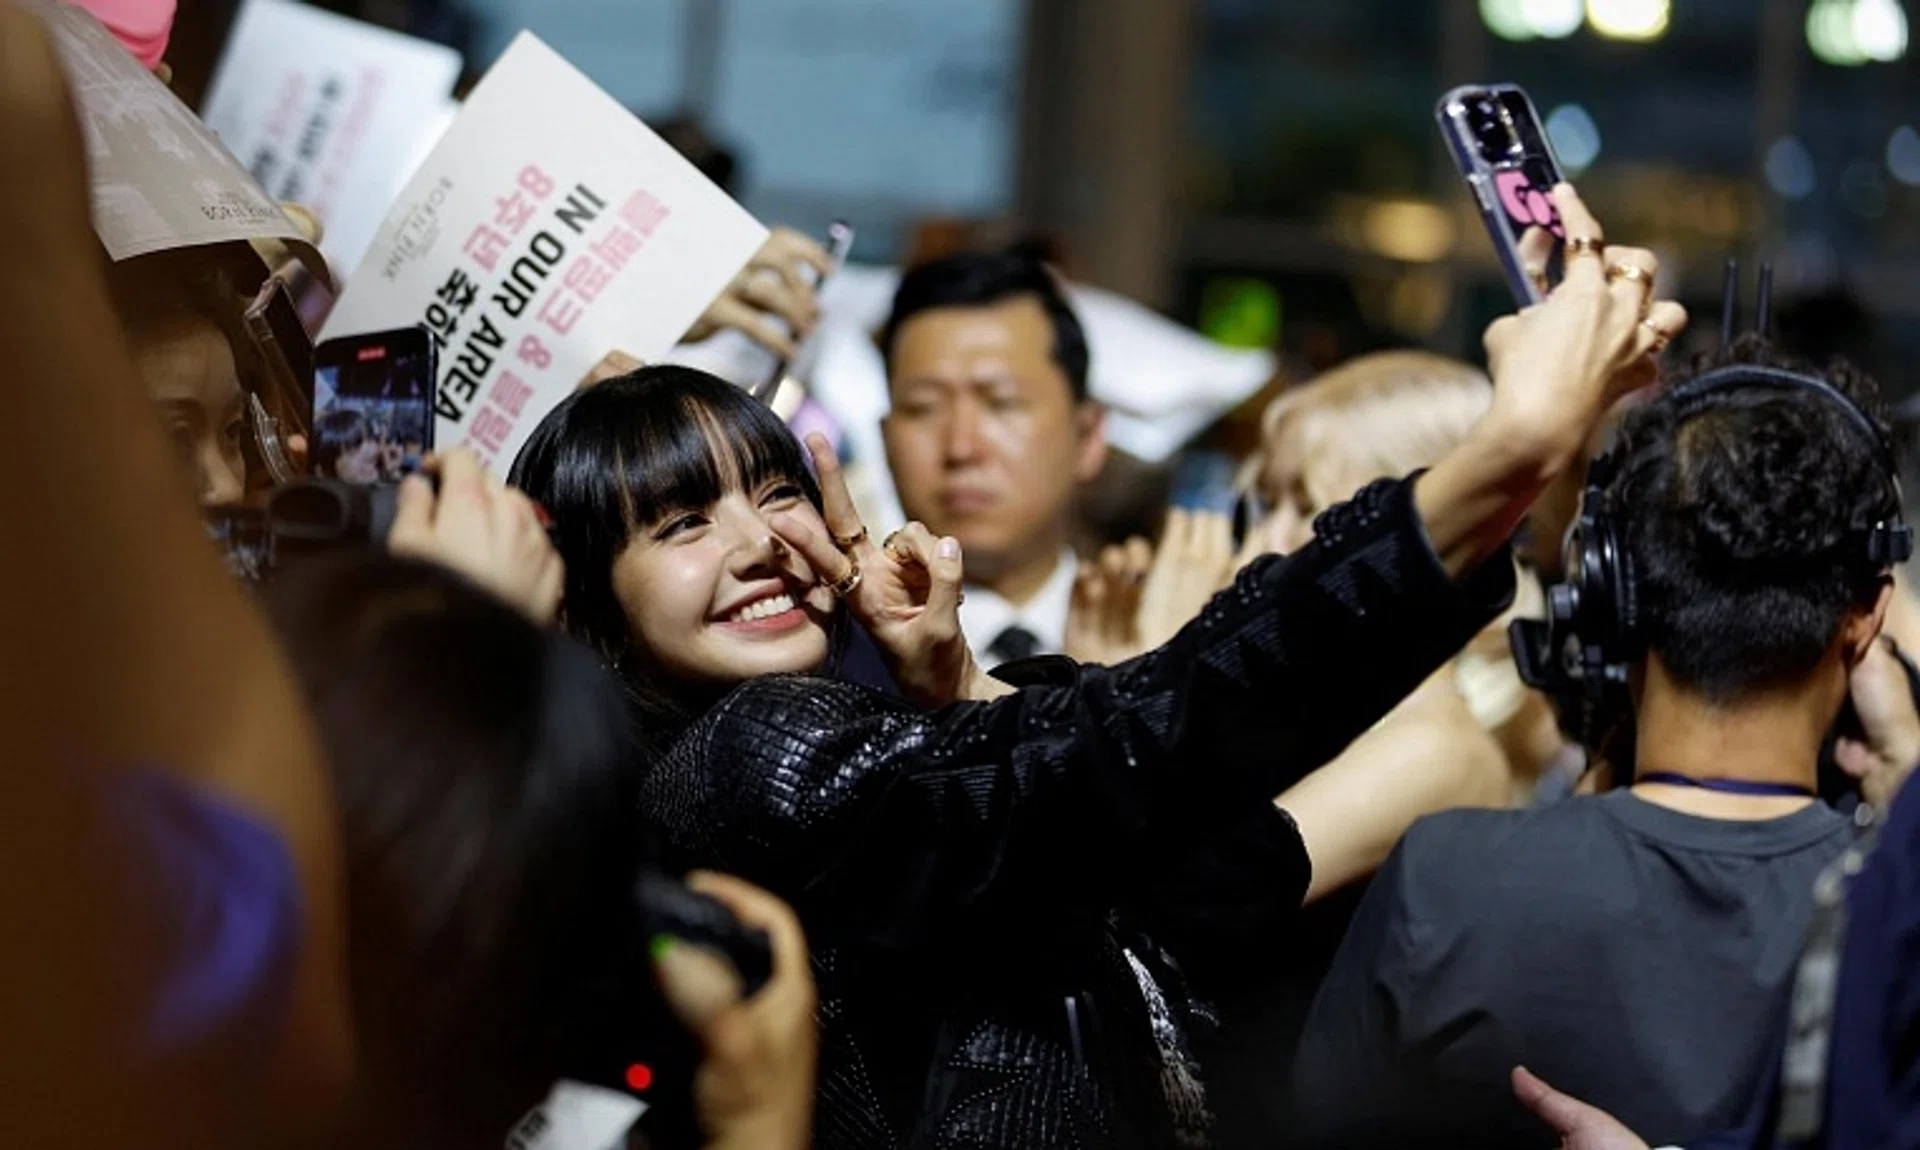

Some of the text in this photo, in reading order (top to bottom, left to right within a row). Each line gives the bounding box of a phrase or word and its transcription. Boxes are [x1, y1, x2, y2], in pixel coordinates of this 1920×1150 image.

[461, 164, 554, 275] 8주년
[536, 186, 671, 336] 블랙핑크
[436, 183, 607, 421] IN OUR AREA
[515, 333, 555, 368] &
